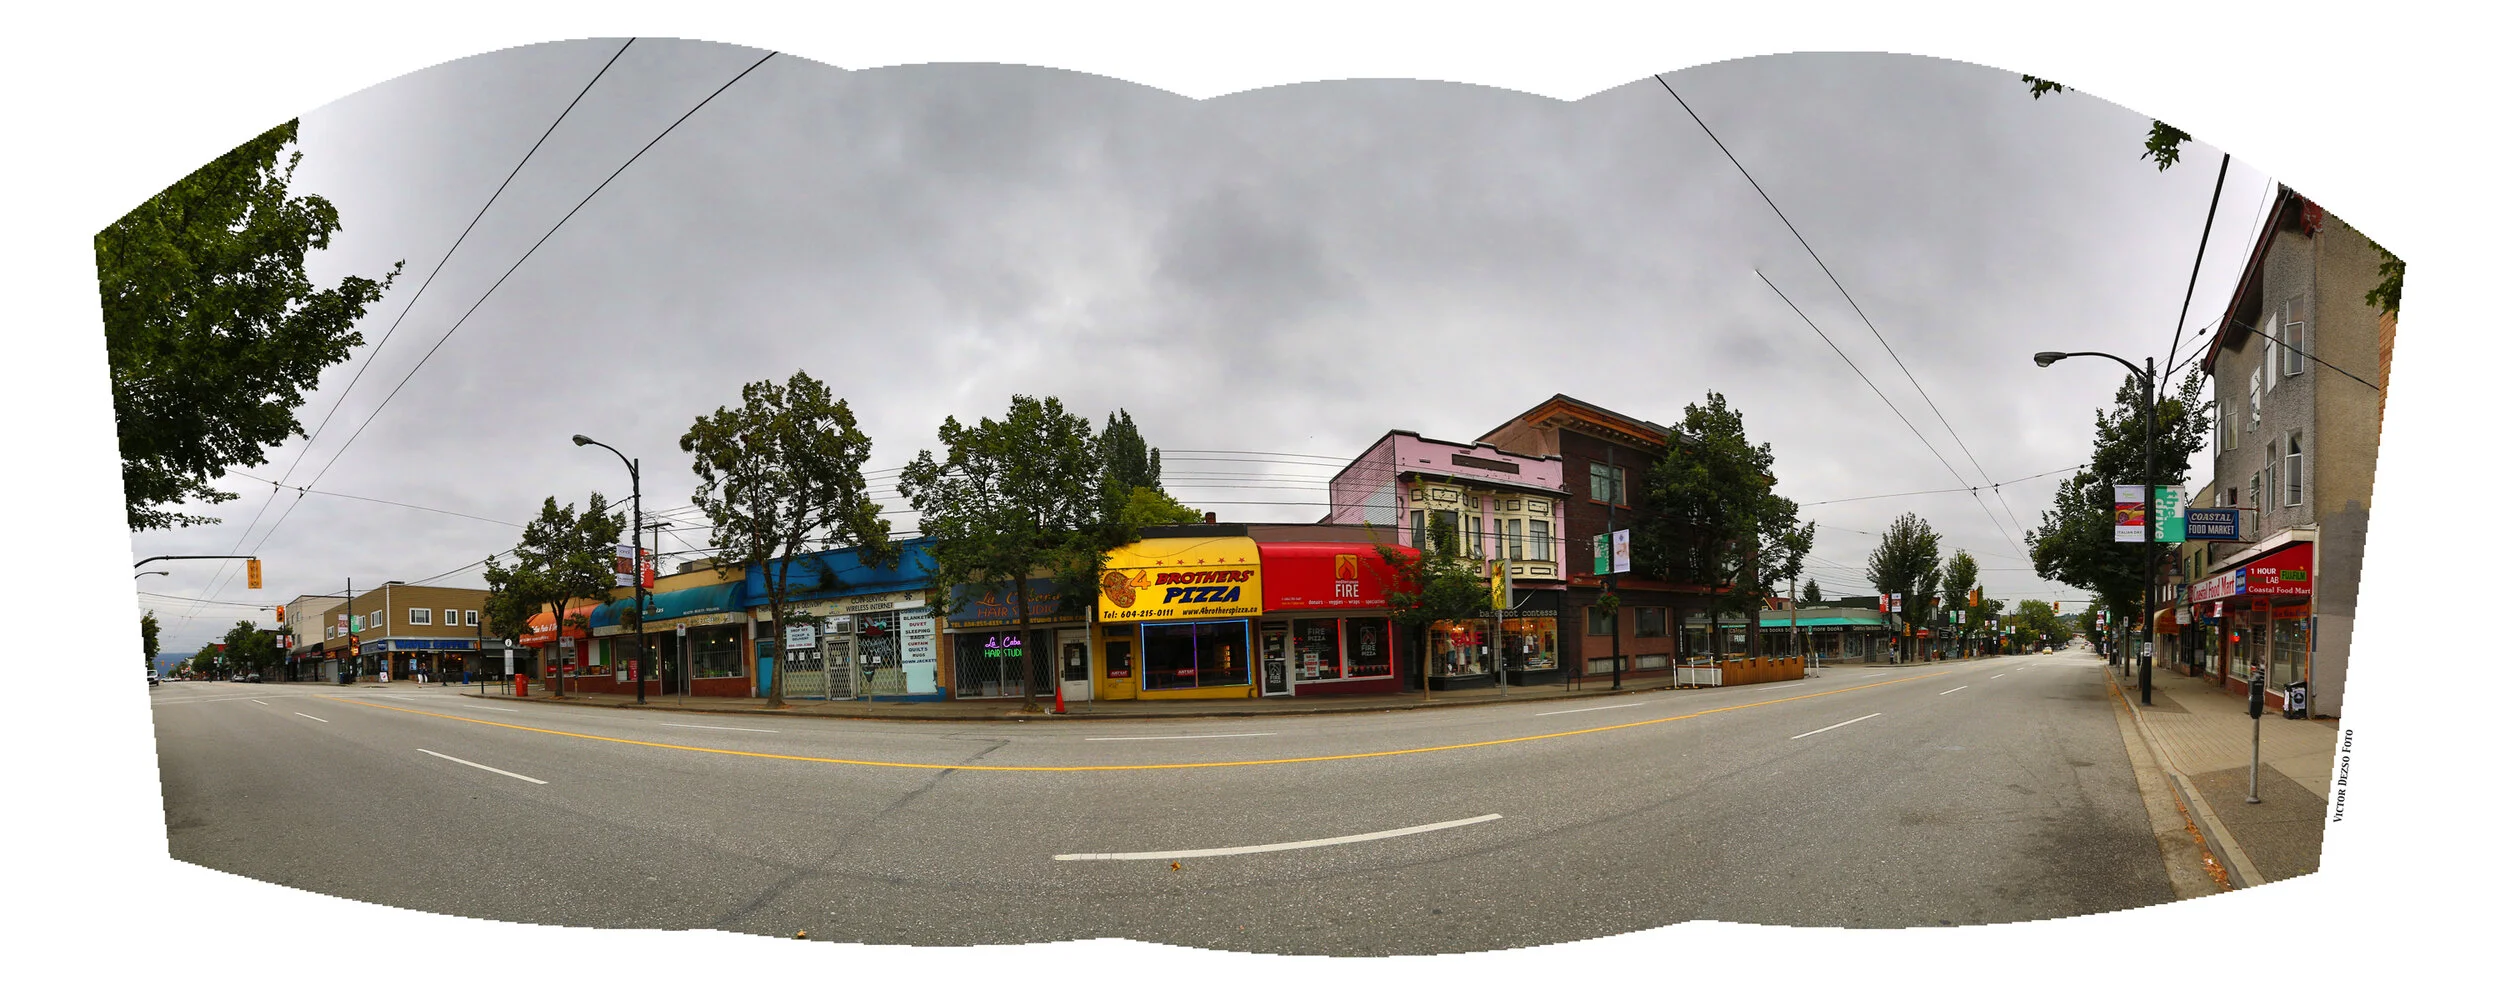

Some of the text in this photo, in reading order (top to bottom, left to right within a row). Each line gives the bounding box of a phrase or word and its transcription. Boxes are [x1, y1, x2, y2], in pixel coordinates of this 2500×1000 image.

[2167, 490, 2179, 518] the
[2155, 499, 2168, 539] drive
[2191, 512, 2231, 521] COASTAL
[2188, 524, 2235, 535] FOOD MARKET
[1130, 569, 1254, 590] 4 BROTHERS'
[2266, 576, 2279, 584] LAB
[2281, 571, 2306, 580] FUJIFILM
[1335, 584, 1359, 598] FIRE
[2194, 575, 2235, 601] Coastal Food Mart
[2248, 586, 2275, 594] Coastal
[2276, 586, 2294, 594] Food
[974, 591, 1003, 607] La
[1163, 586, 1241, 604] PIZZA
[846, 602, 894, 612] WIRELESS INTERNET
[977, 607, 1009, 618] HAIR
[1103, 606, 1258, 619] Tel: 604-215-0111 www.4brotherspizza.ca
[984, 636, 1000, 649] La
[1450, 632, 1484, 647] SALE
[984, 648, 1022, 658] HAIR STUDI
